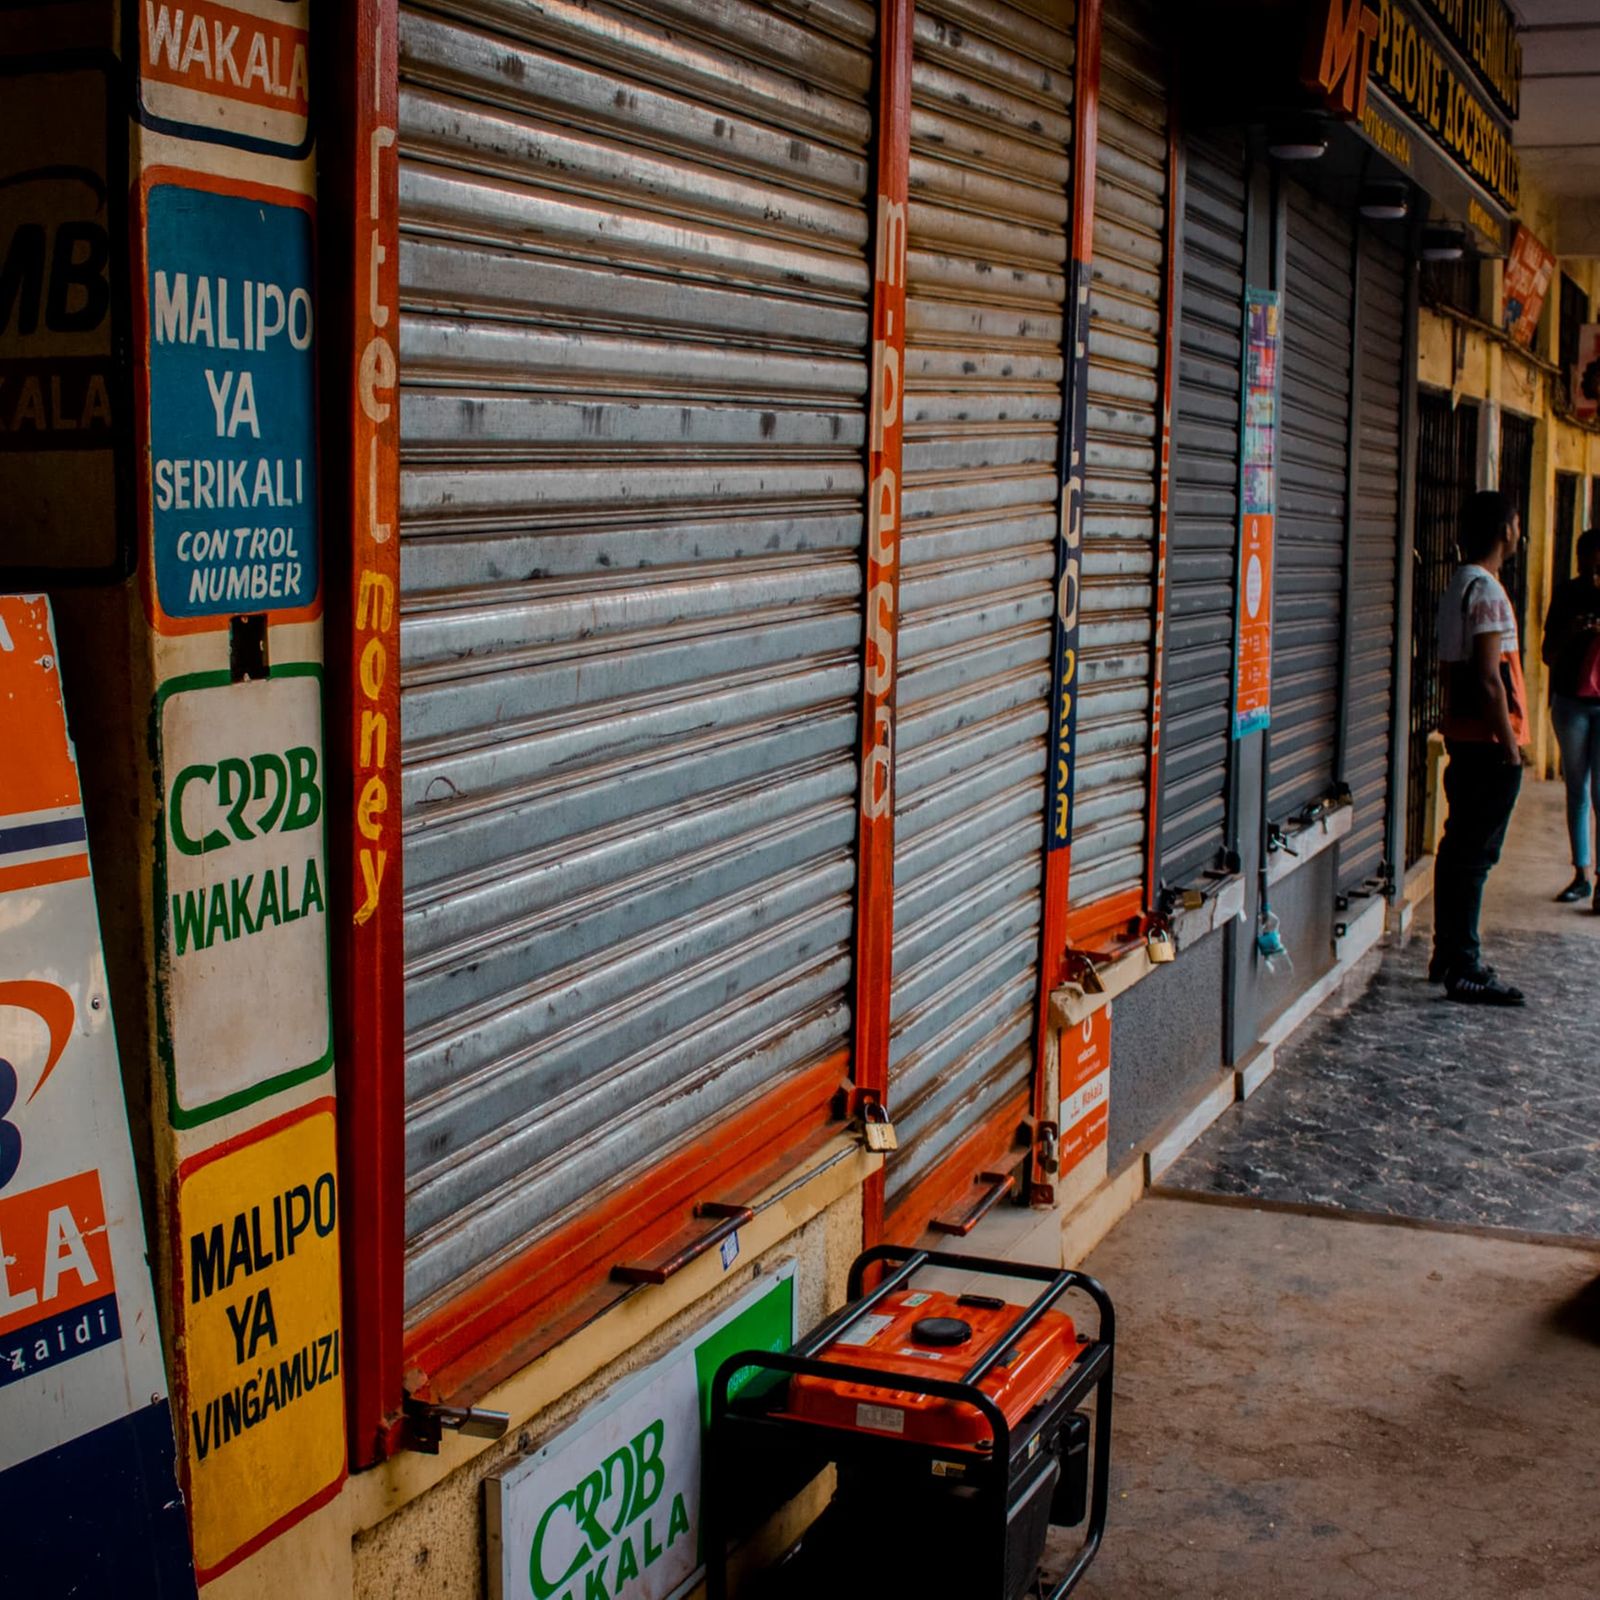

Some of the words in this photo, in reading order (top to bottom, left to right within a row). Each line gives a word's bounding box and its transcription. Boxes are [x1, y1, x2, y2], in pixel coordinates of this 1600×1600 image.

[146, 0, 308, 101] WAKALA
[154, 269, 313, 351] MALIPO
[205, 369, 261, 439] YA
[155, 457, 303, 512] SERIKALI
[176, 527, 299, 563] CONTROL
[188, 561, 302, 604] NUMBER
[353, 569, 396, 927] money
[170, 747, 322, 856] CRDB
[173, 858, 325, 957] WAKALA
[190, 1172, 336, 1304] MALIPO
[9, 1307, 108, 1373] zaidi
[226, 1287, 278, 1366] YA
[191, 1329, 340, 1461] VING'AMUZI
[530, 1418, 666, 1600] CRDB
